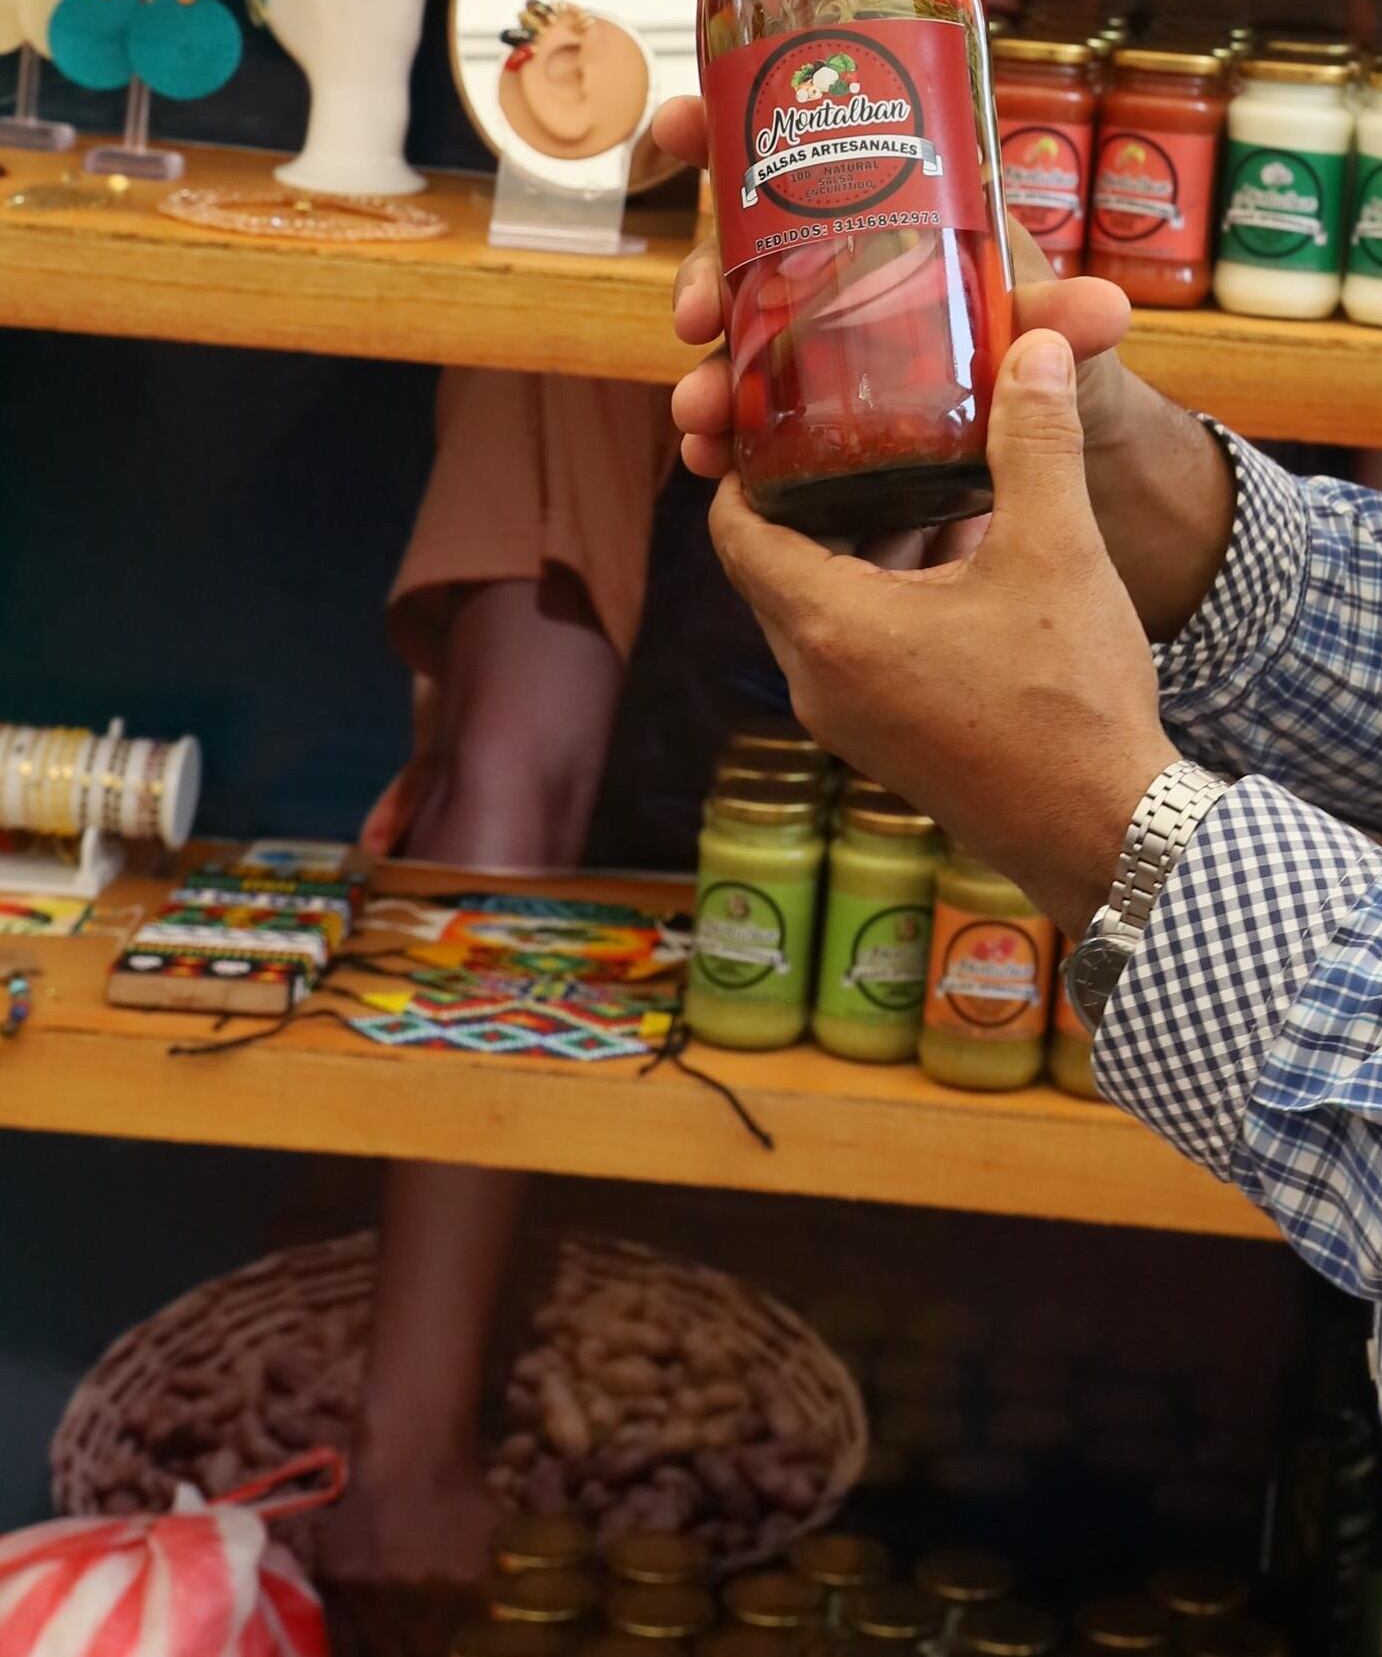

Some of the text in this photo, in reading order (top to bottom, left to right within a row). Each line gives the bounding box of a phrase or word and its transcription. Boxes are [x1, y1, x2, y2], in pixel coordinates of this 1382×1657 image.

[757, 95, 909, 155] Montalban
[757, 139, 919, 182] SALSAS ARTESANALES
[816, 174, 855, 187] SALSA
[824, 160, 881, 177] NATURAL
[756, 210, 942, 253] PEDIDOS: 3116842973
